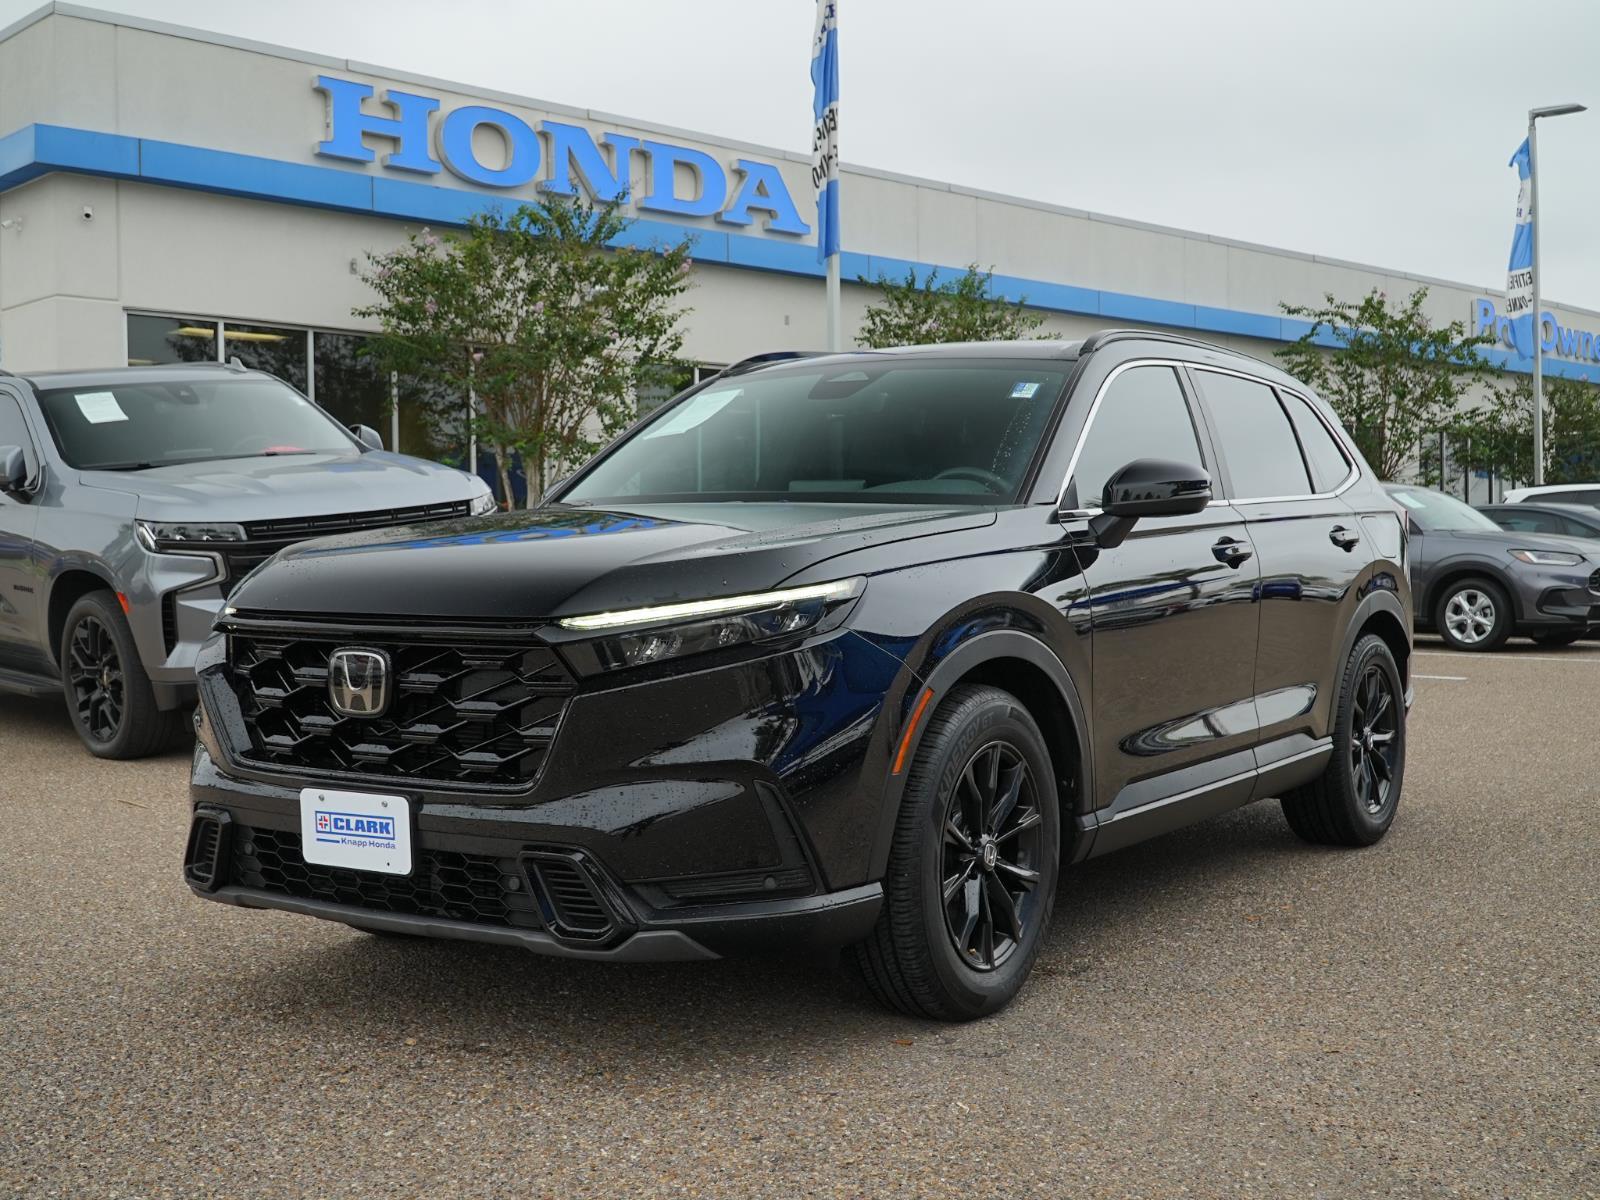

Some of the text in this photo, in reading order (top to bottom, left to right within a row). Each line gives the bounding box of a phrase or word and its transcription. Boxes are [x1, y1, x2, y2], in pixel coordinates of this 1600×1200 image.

[314, 75, 811, 236] HONDA
[938, 717, 980, 806] KINERGY
[333, 817, 391, 835] CLARK
[340, 838, 396, 850] Knapp Honda
